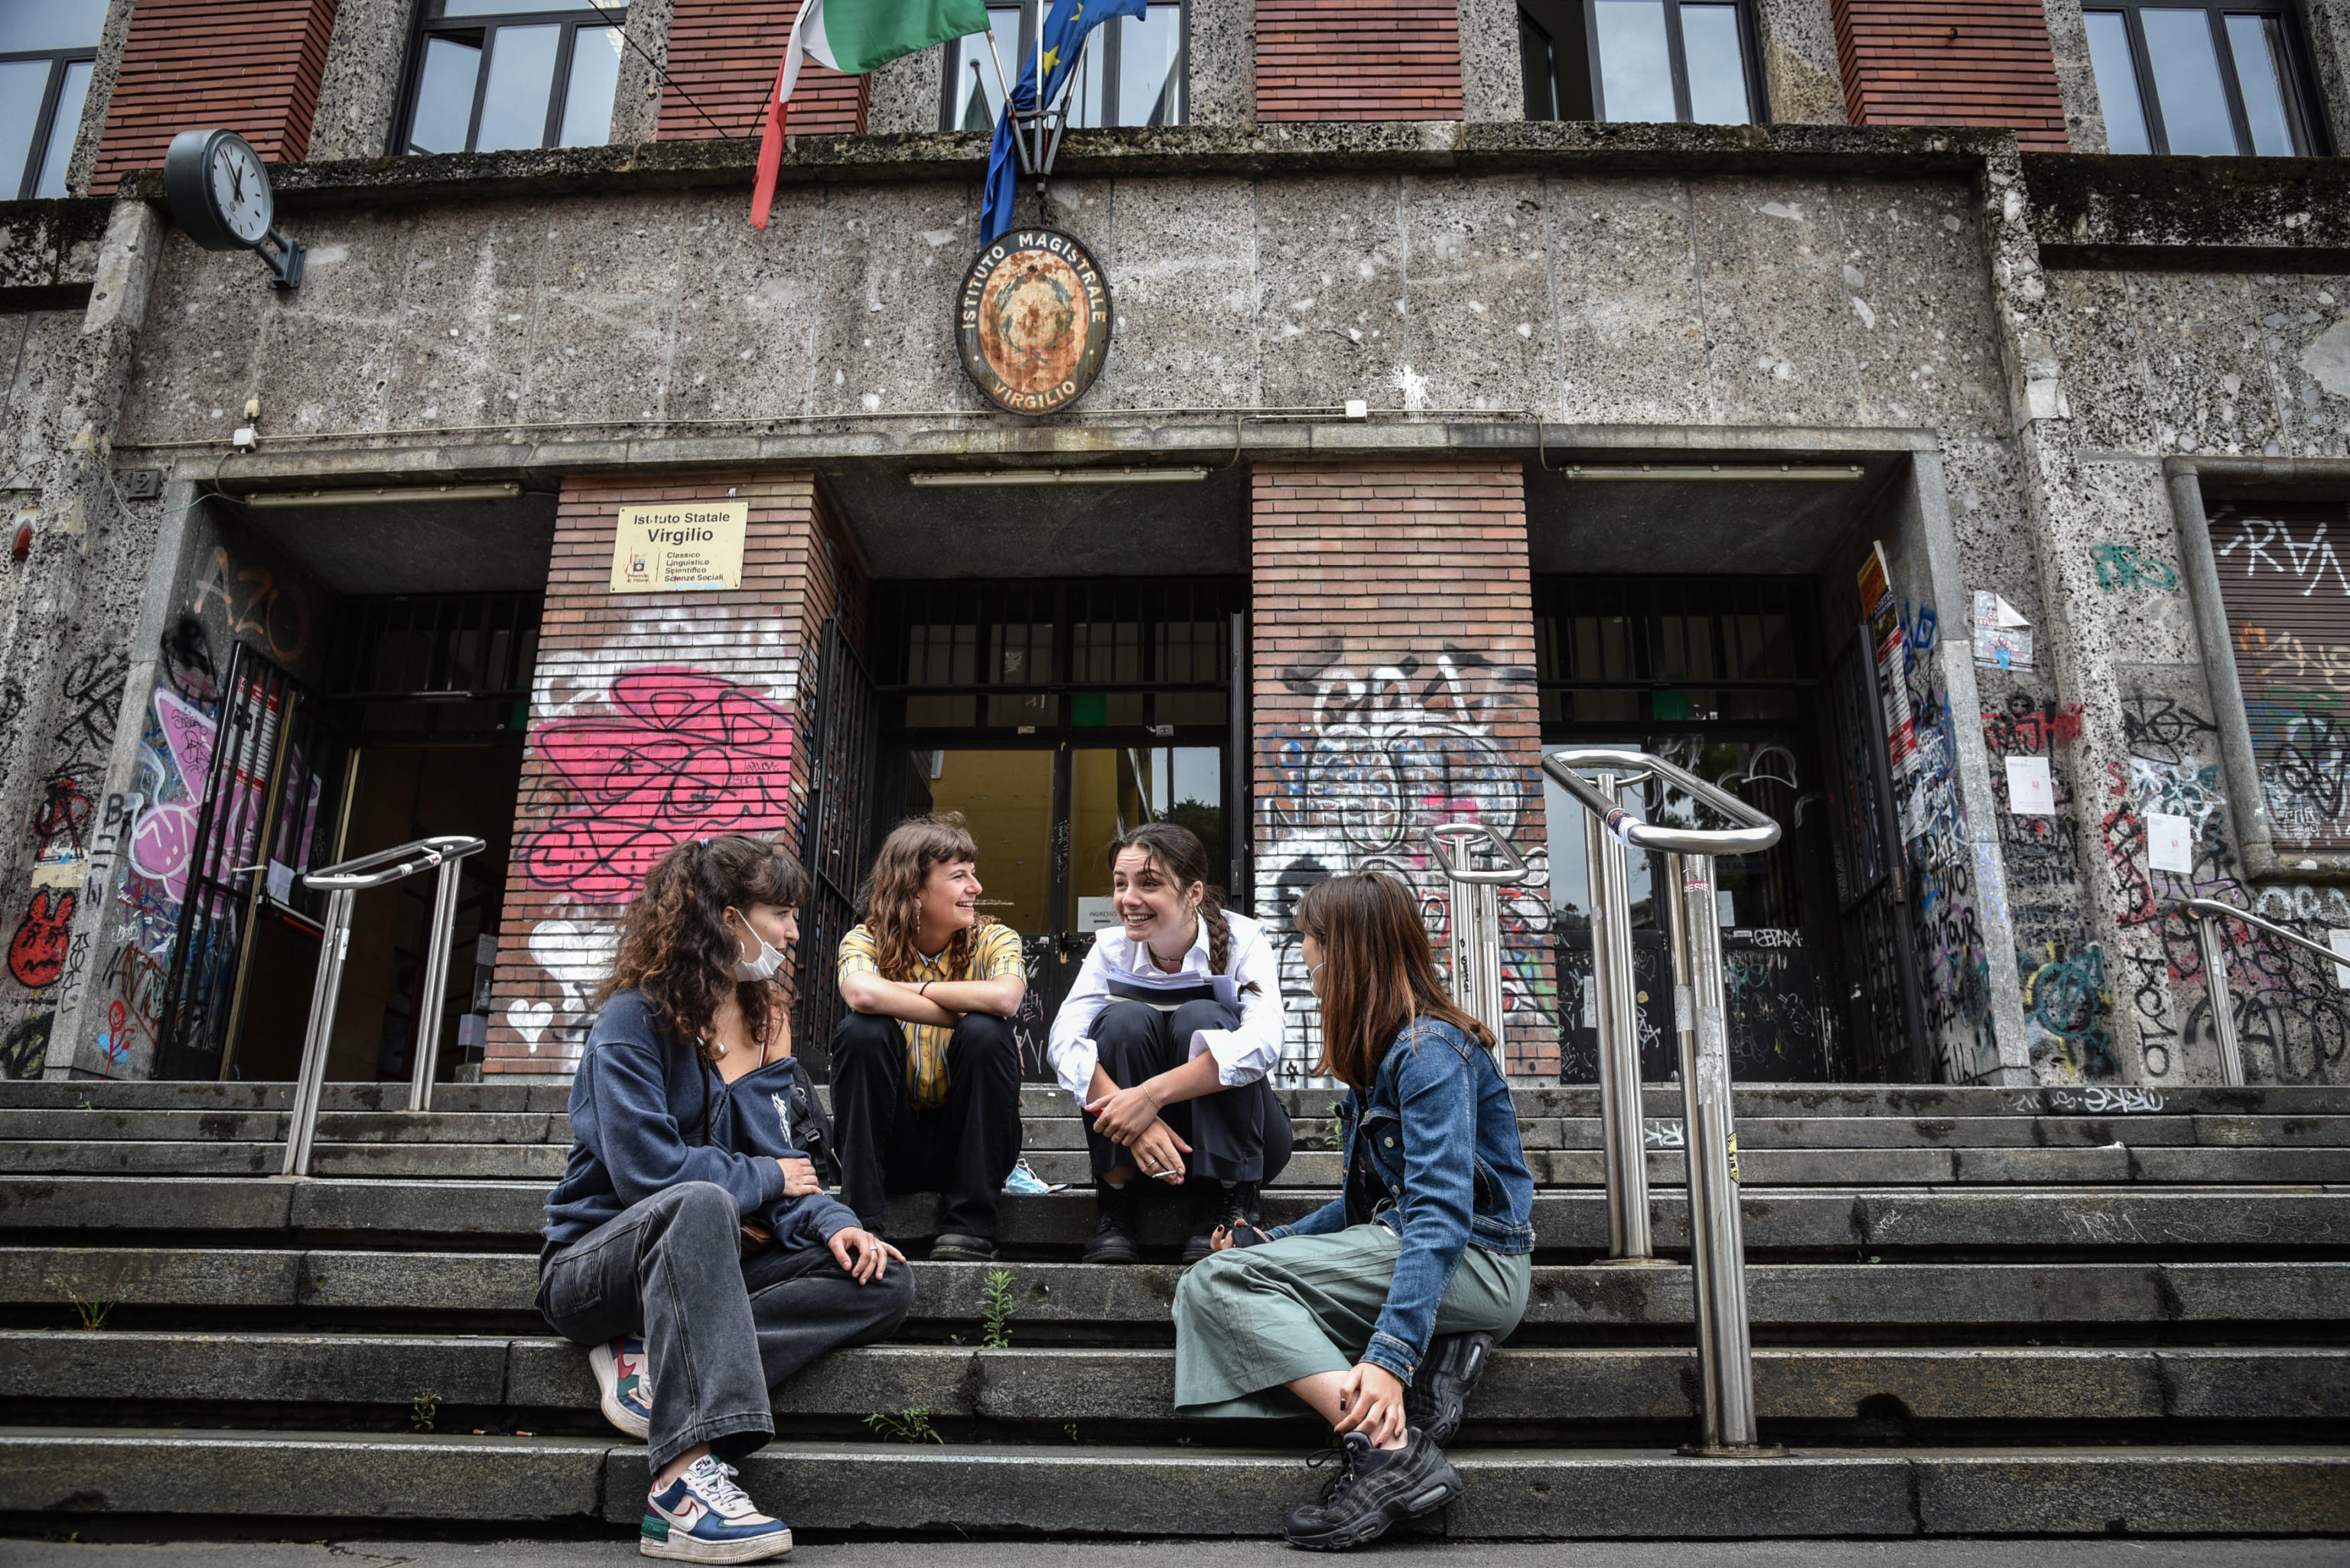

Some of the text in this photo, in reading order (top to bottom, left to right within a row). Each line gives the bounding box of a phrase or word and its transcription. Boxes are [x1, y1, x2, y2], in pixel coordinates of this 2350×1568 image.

[962, 233, 1106, 329] ISTITUTO MAGISTRALE
[993, 380, 1076, 409] VIRGILIO
[634, 512, 730, 525] Isttuto Statale
[648, 527, 714, 545] Virgilio
[665, 566, 707, 574] Scientifico
[666, 559, 710, 568] Linguistico
